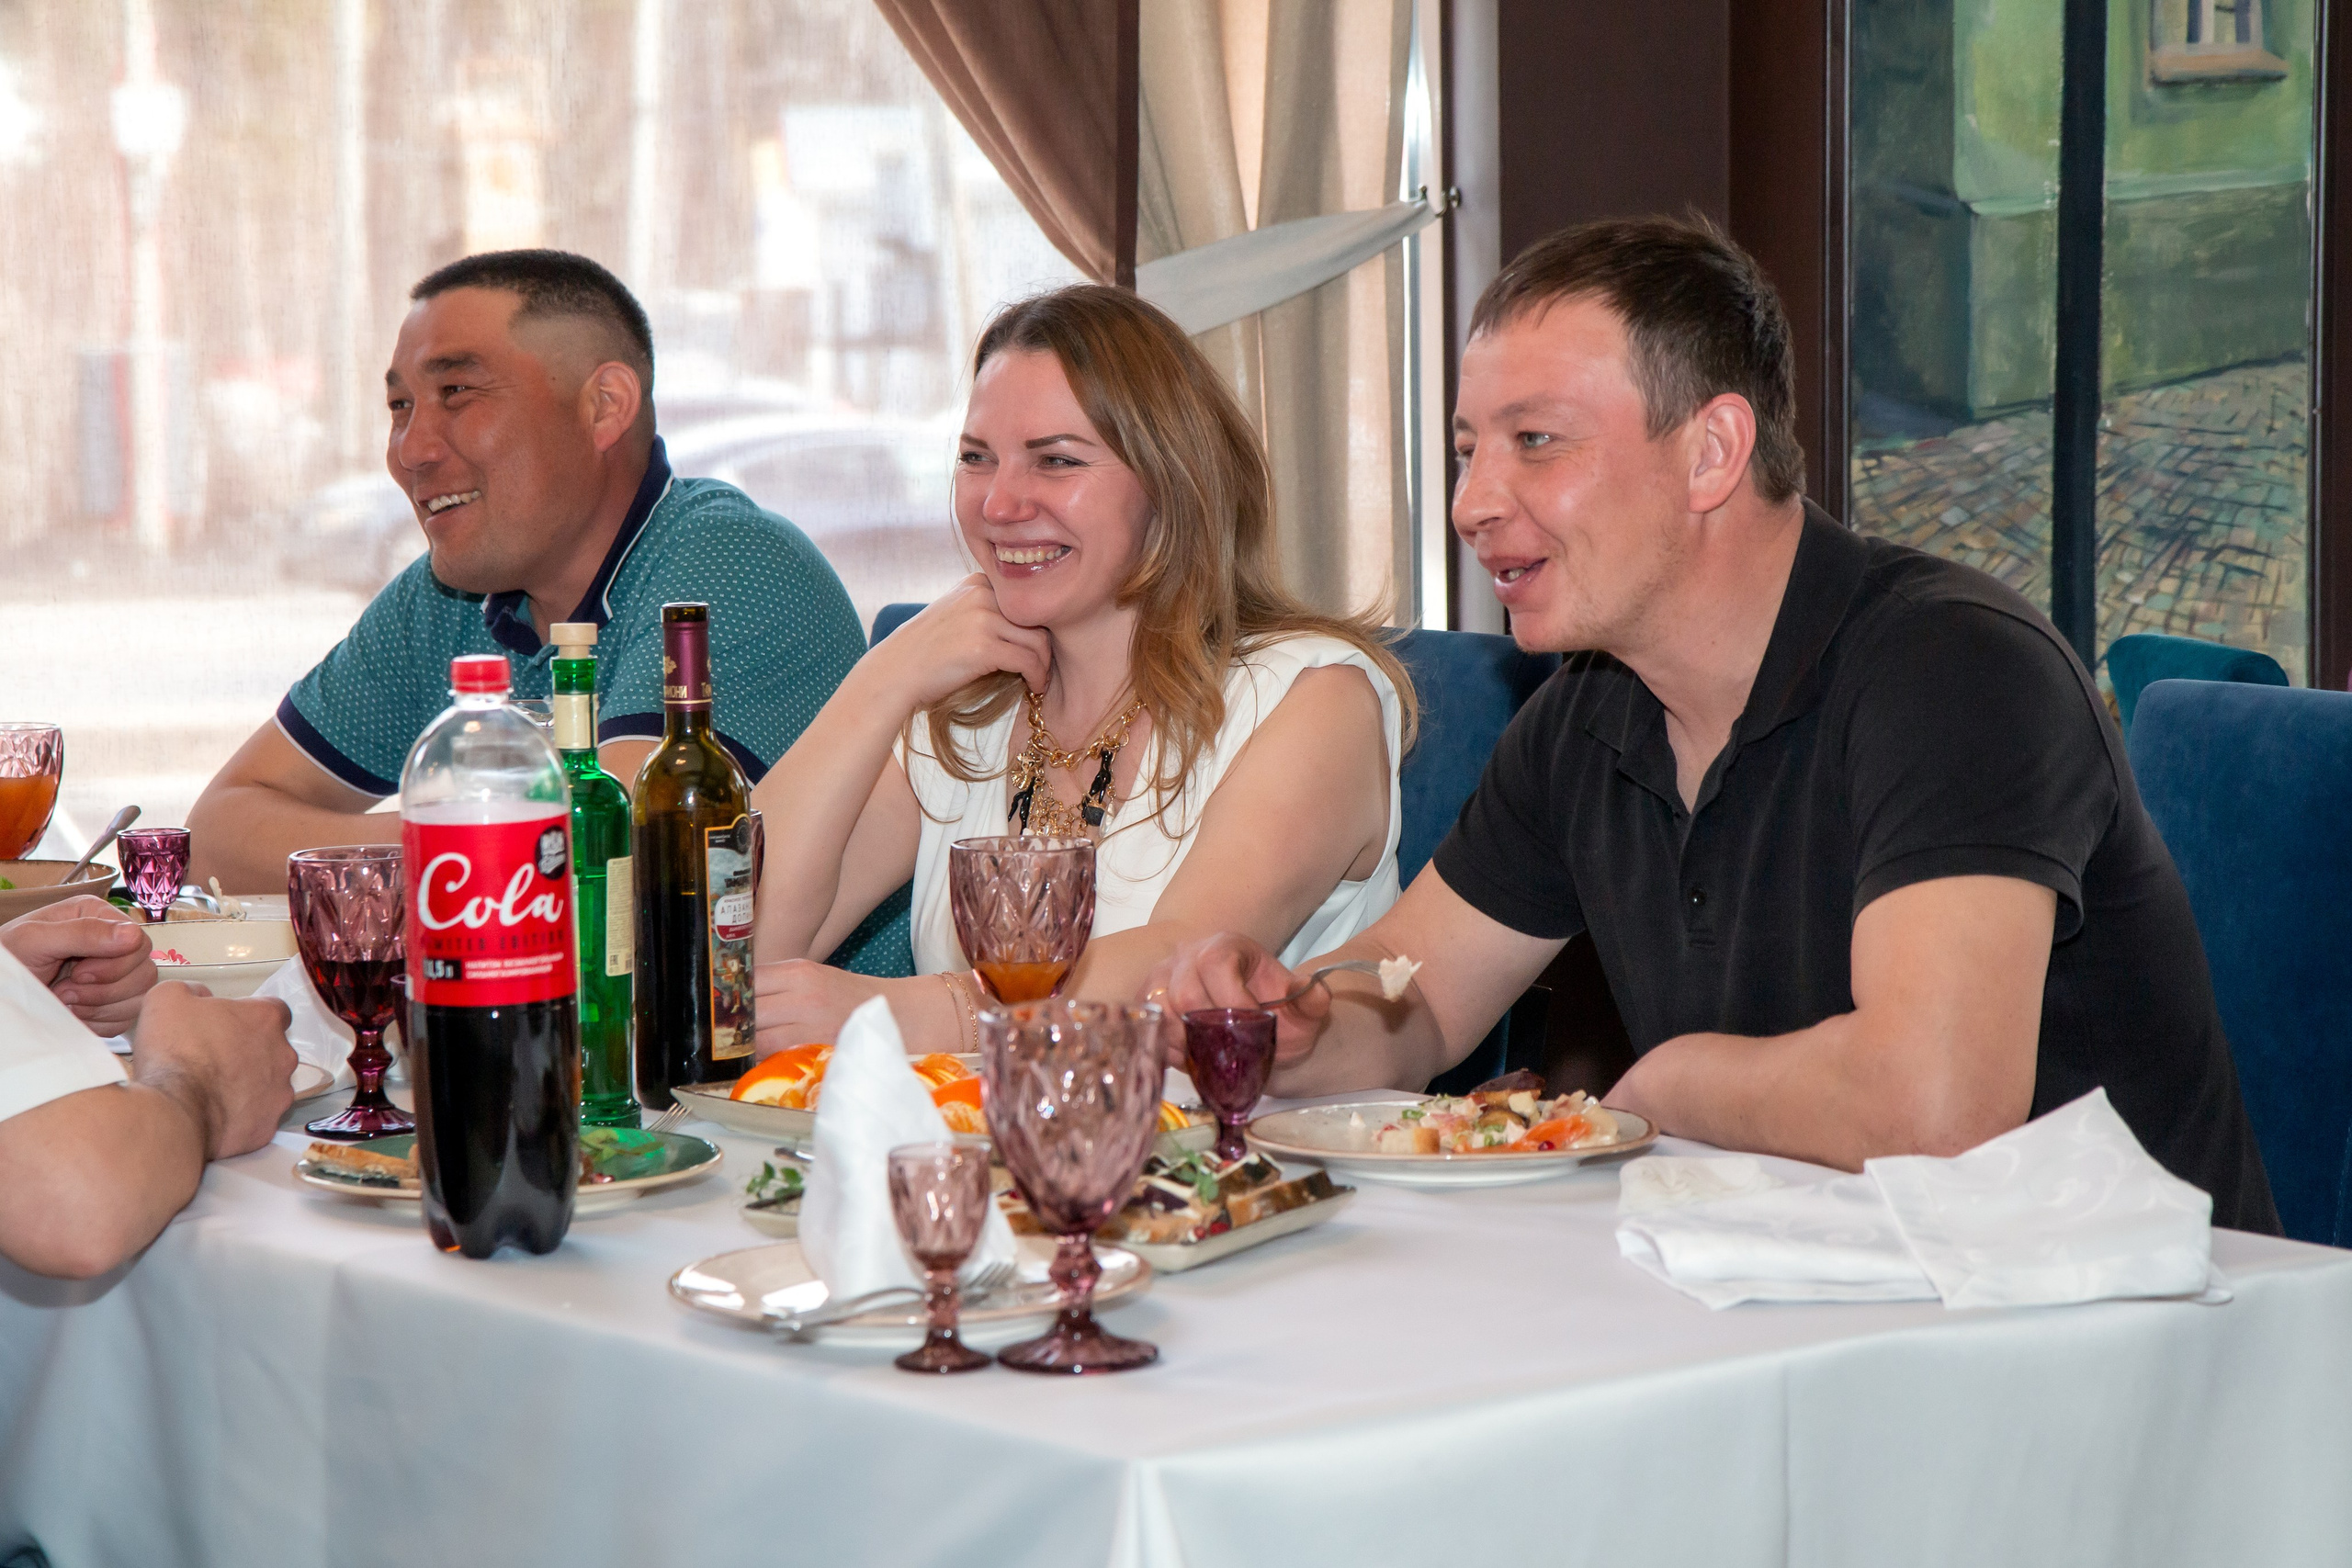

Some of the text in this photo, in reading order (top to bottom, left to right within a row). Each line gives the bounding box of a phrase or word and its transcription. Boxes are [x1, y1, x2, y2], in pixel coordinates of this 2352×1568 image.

[418, 852, 564, 930] Cola
[720, 903, 752, 914] АЛАЗАН
[421, 935, 486, 953] MITED
